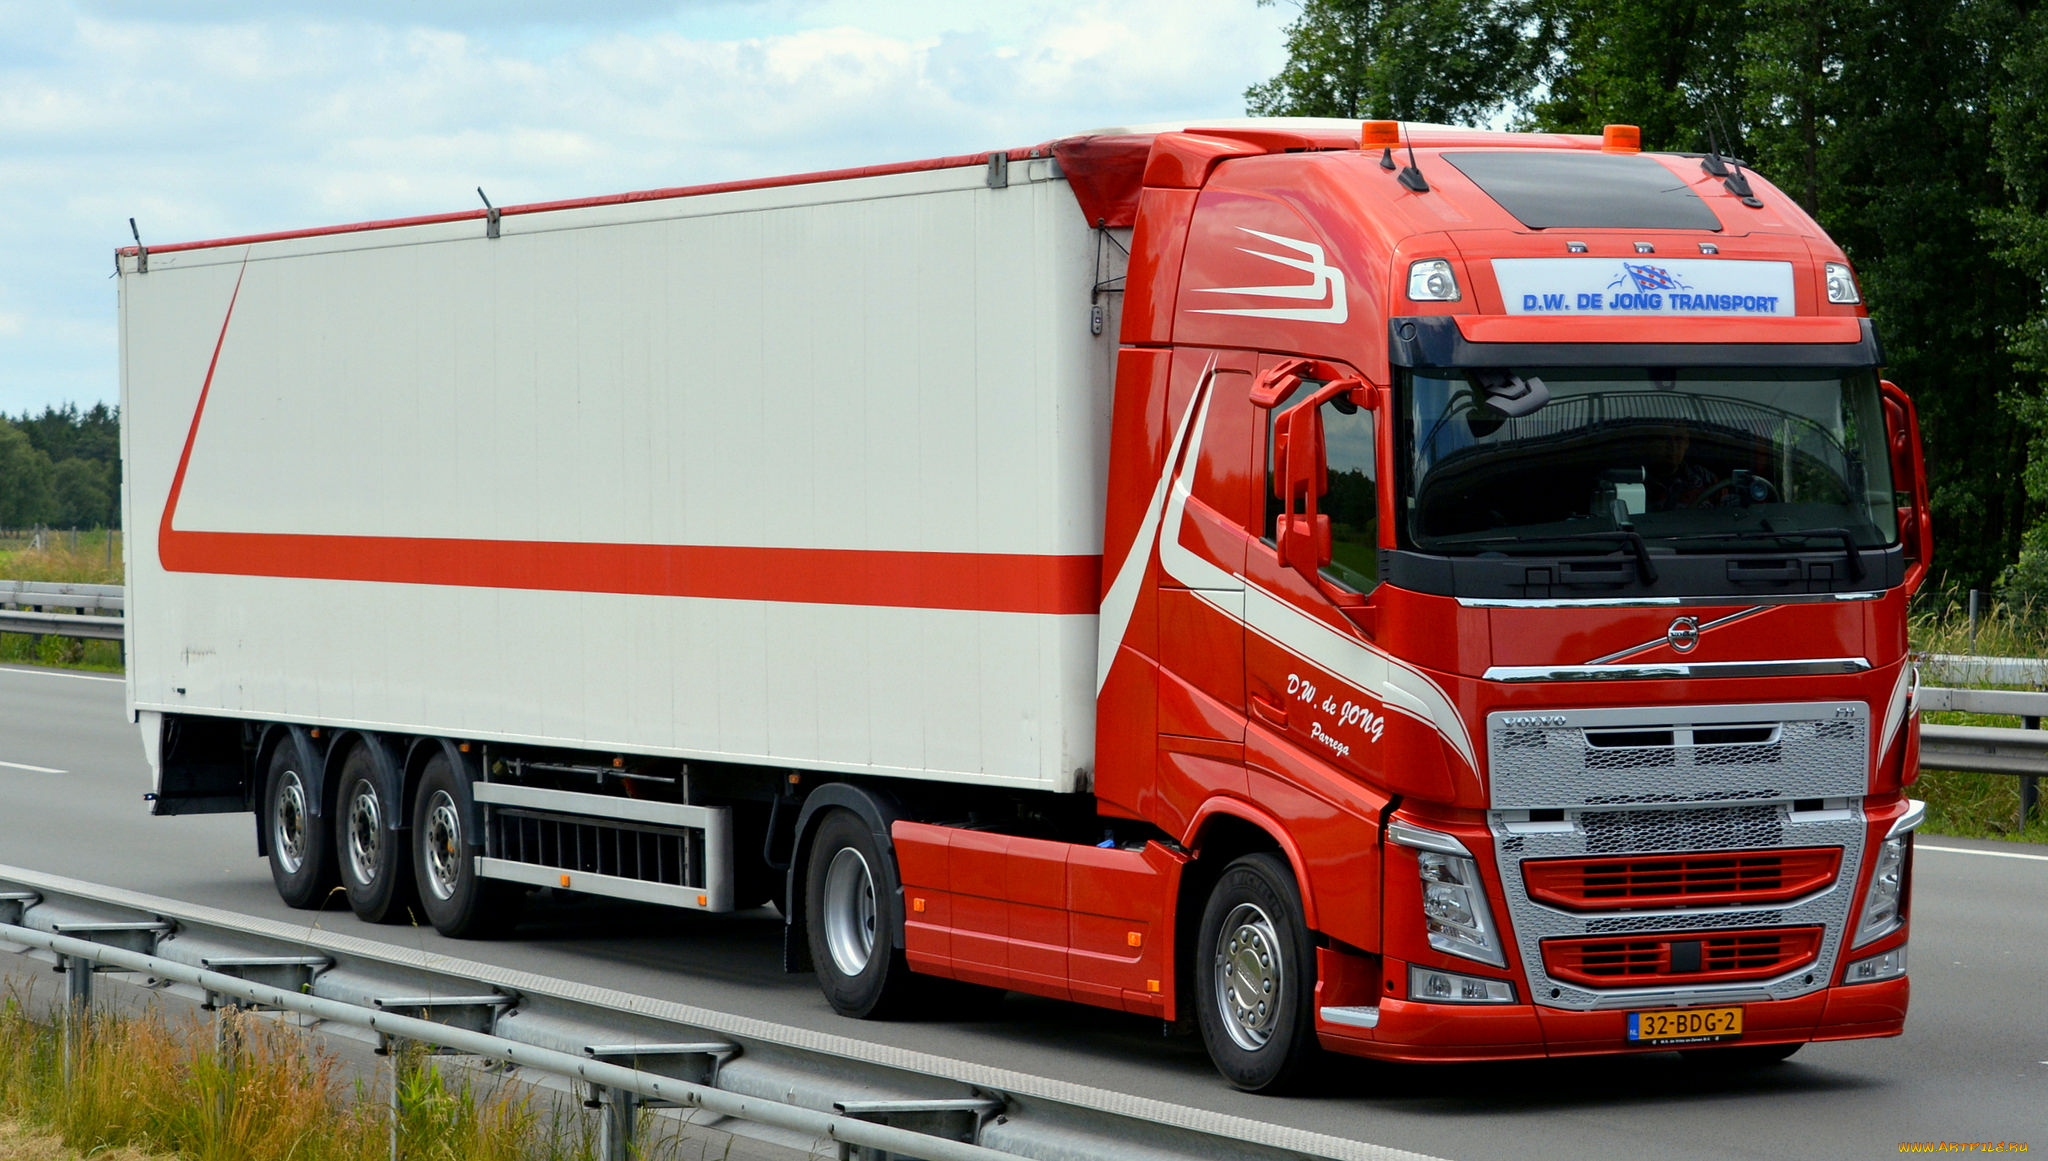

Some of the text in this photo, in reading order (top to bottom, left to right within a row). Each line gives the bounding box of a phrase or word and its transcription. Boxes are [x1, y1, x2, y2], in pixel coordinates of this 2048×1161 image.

[1523, 293, 1779, 313] D.W. DE JONG TRANSPORT
[1287, 673, 1384, 743] D.W. de JONG
[1835, 706, 1856, 718] FH
[1502, 715, 1567, 728] VOLVO
[1311, 721, 1350, 757] Parrega
[1644, 1012, 1736, 1036] 32-BDG-2
